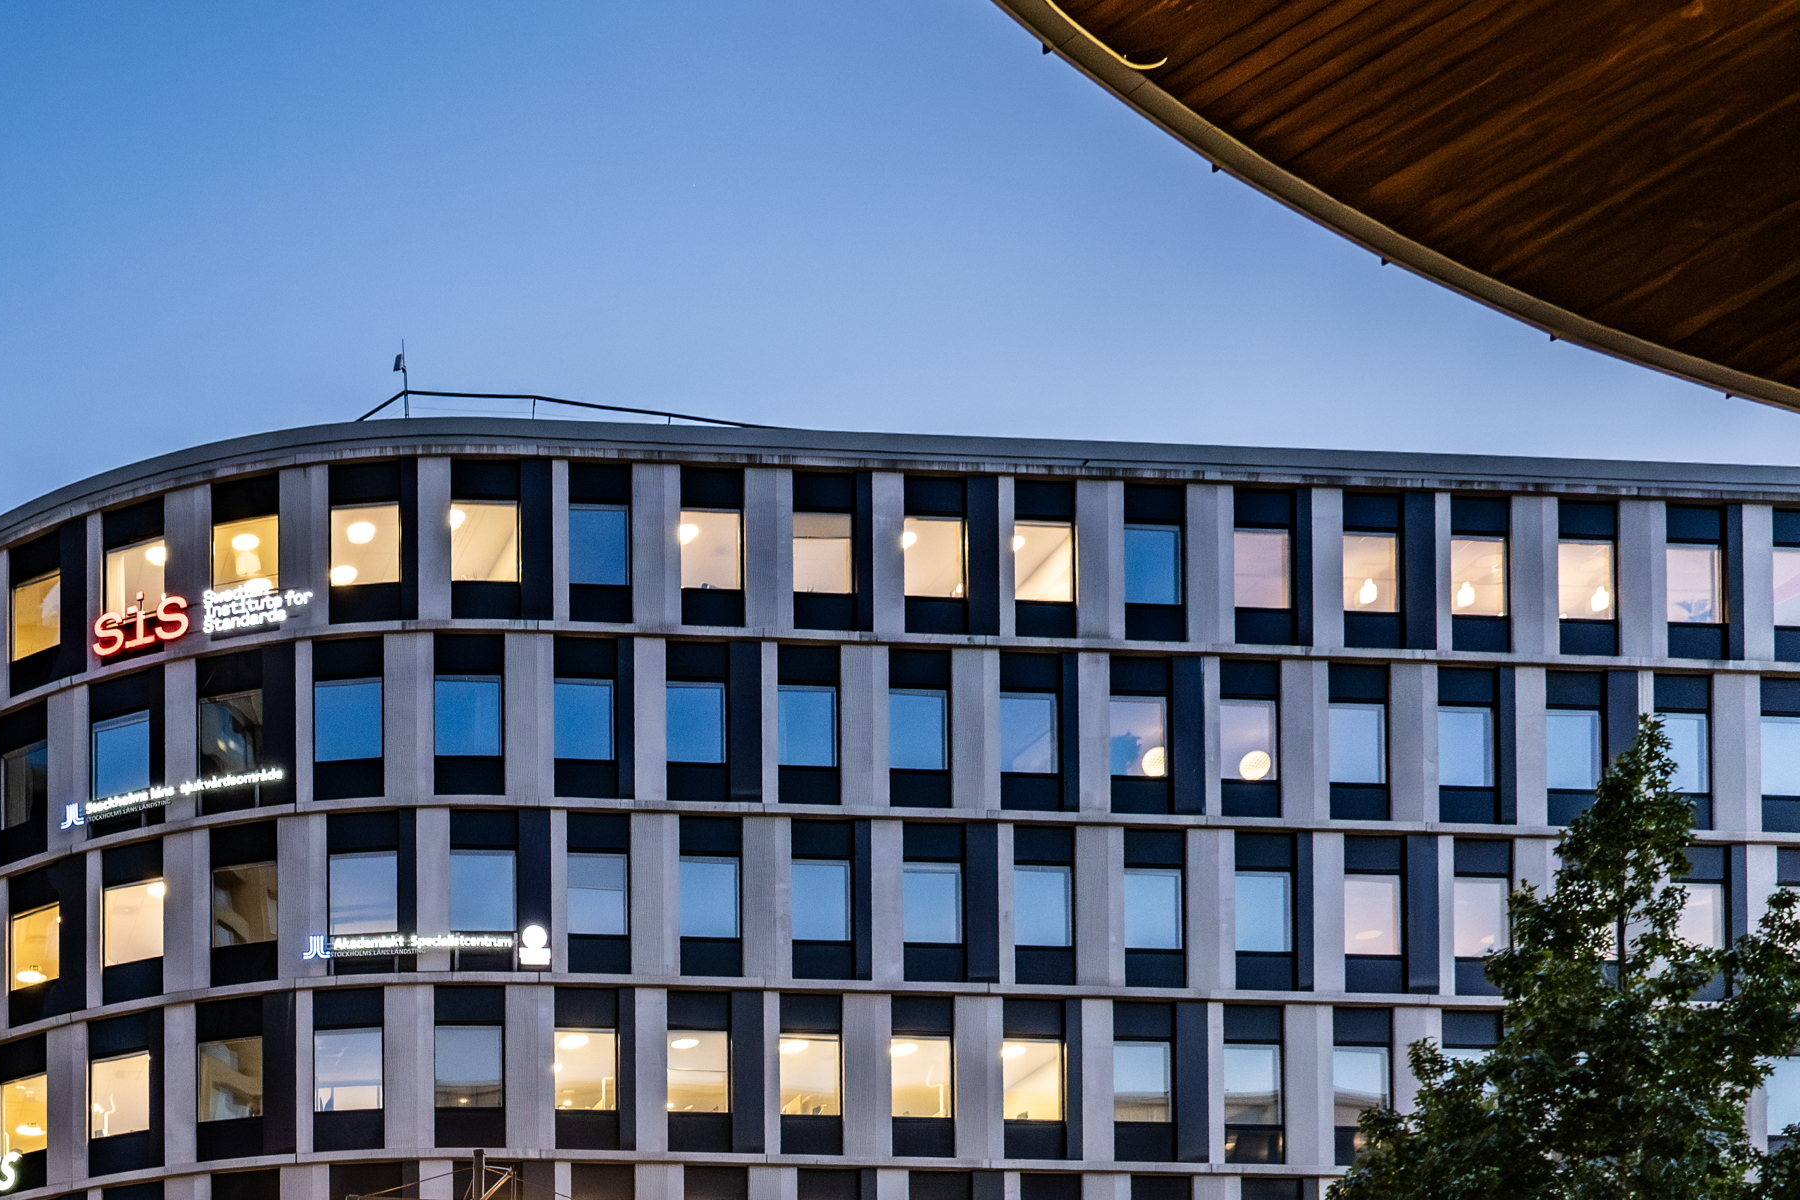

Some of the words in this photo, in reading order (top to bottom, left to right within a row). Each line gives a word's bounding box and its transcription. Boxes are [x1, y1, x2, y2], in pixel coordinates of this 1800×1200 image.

[285, 590, 313, 607] for
[203, 608, 286, 634] Standards
[86, 791, 149, 815] Stockholms
[333, 935, 404, 950] Akademiskt
[411, 934, 513, 949] Specialistcentrum
